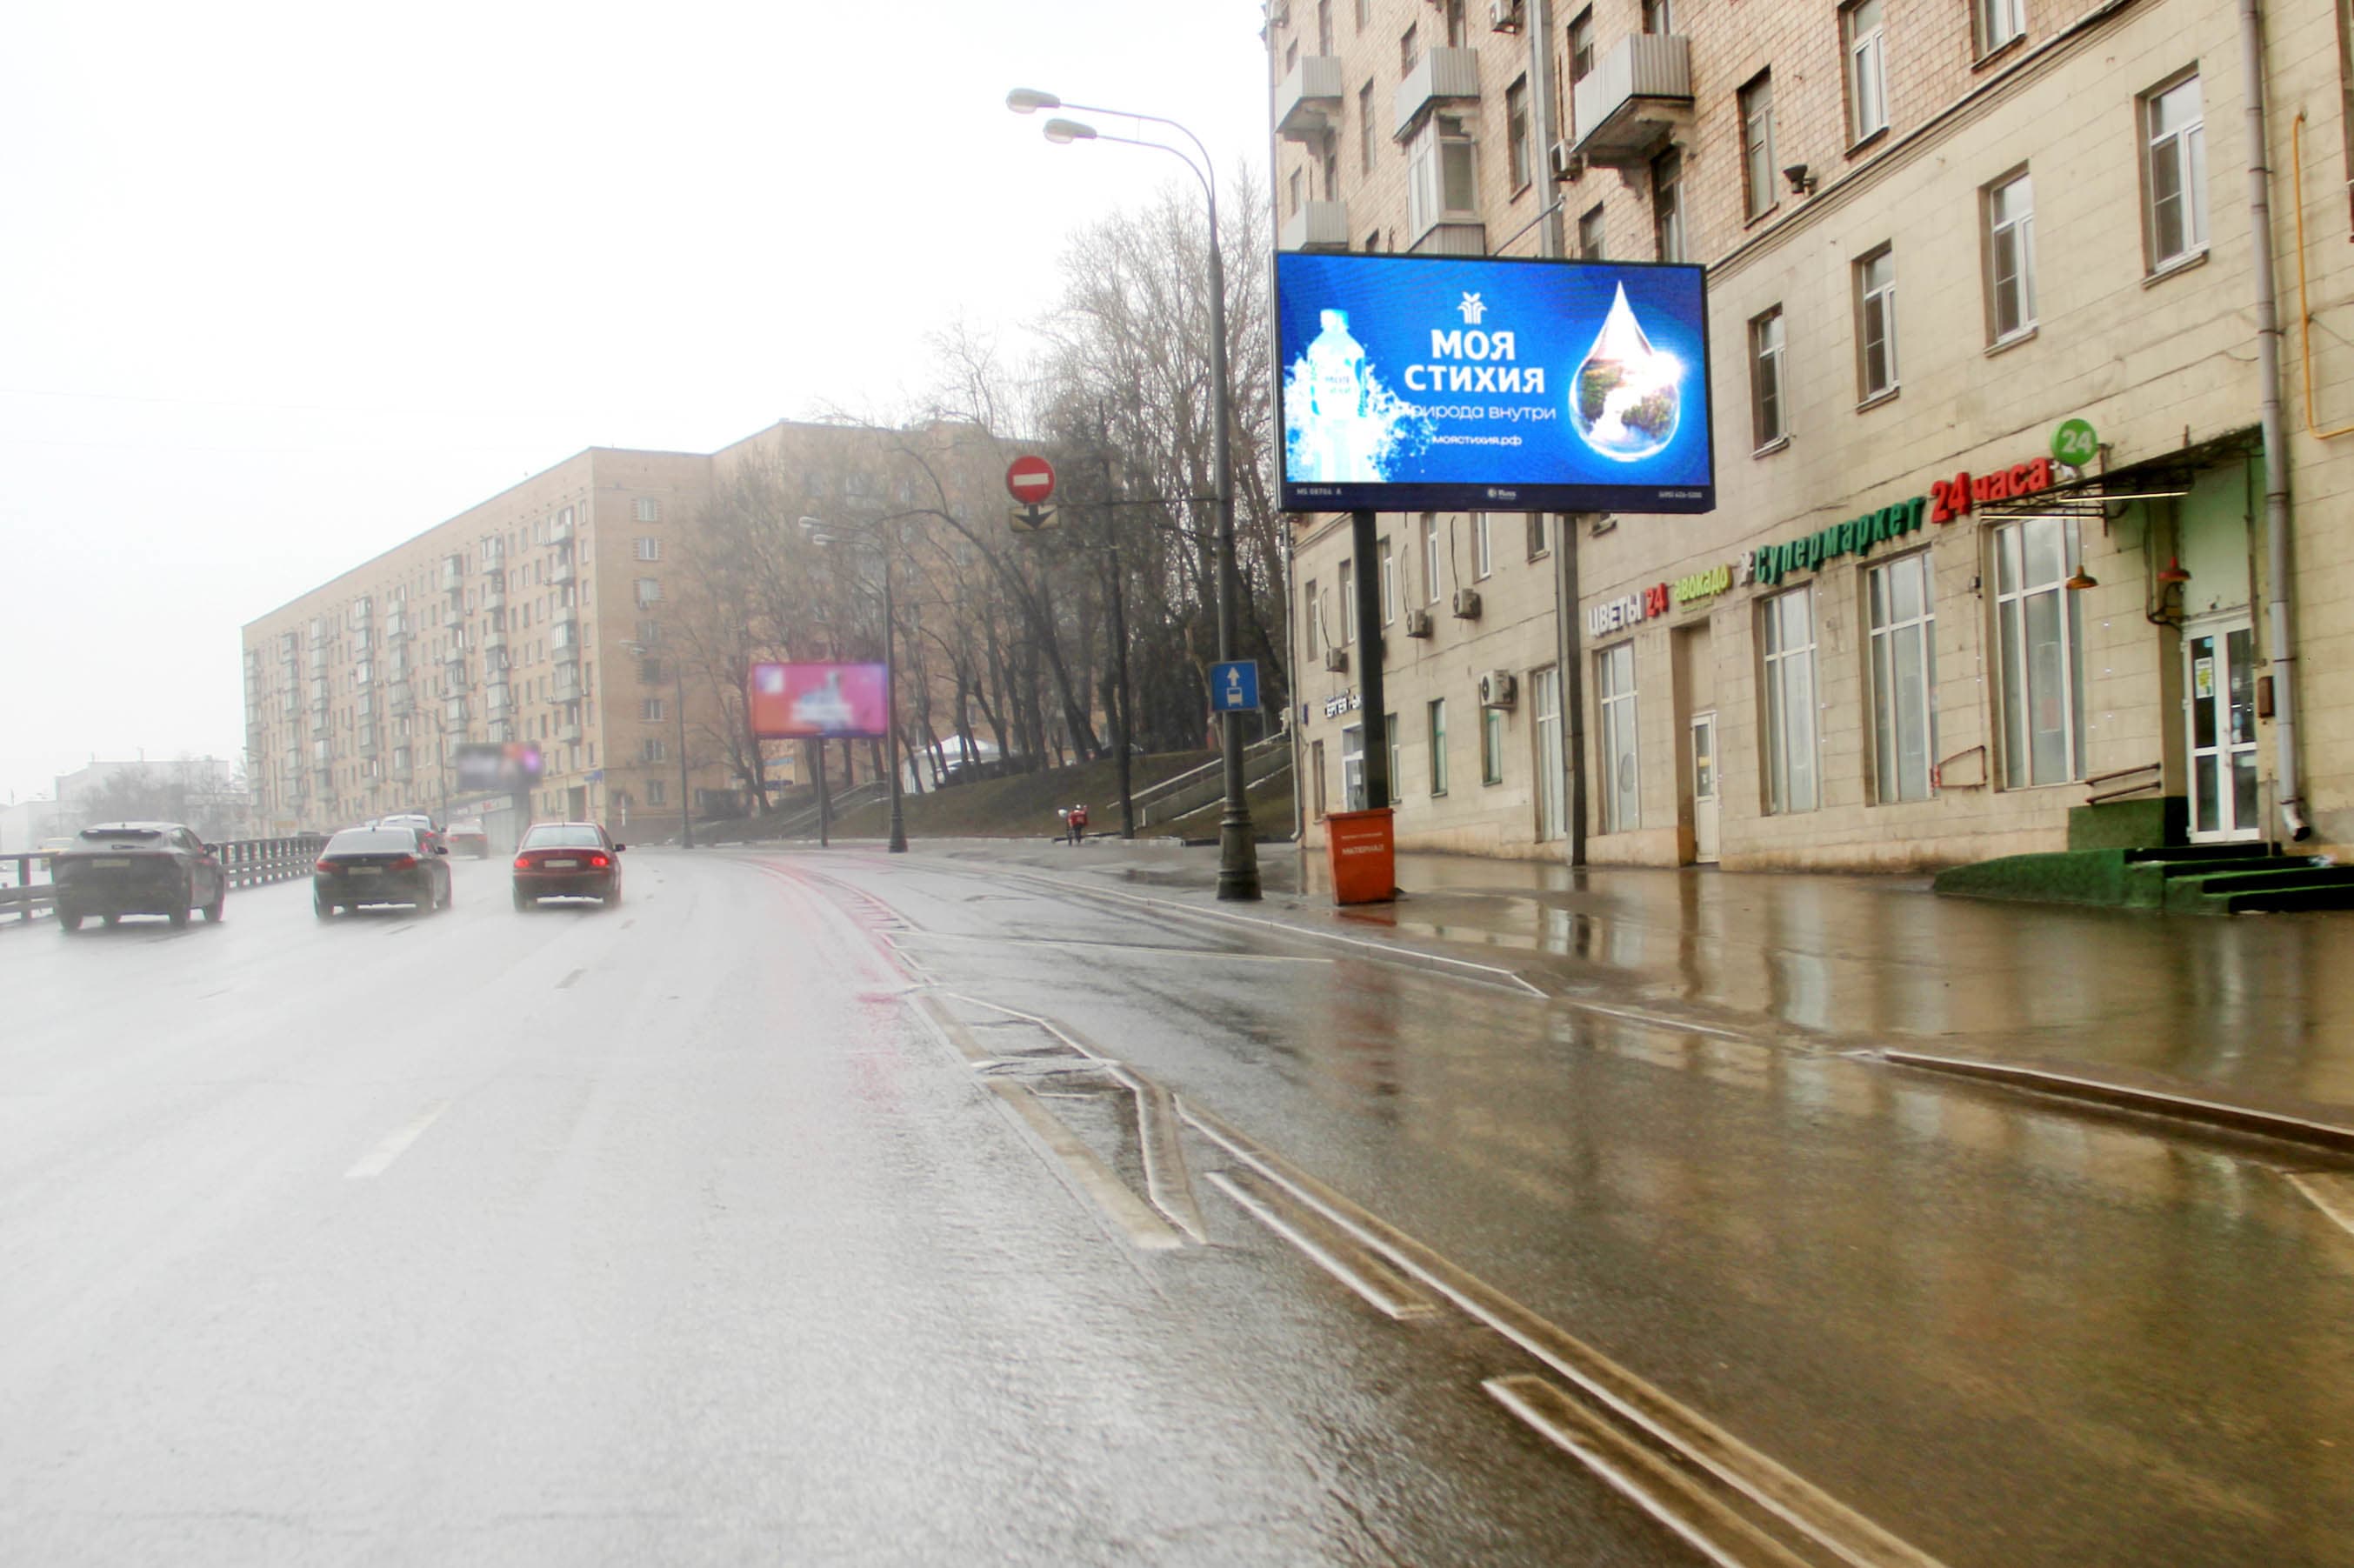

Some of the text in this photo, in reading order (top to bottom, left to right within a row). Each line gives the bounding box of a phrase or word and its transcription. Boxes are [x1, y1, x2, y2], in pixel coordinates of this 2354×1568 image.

[1430, 329, 1516, 361] МОЯ
[1404, 364, 1545, 394] СТИХИЯ
[1399, 404, 1557, 423] рирода внутри
[1432, 435, 1523, 448] моястихия.рф
[2061, 428, 2093, 455] 24
[1755, 457, 2053, 585] Супермаркет 24 часа
[1588, 564, 1733, 637] ЦВЕТЫ 24 авокадо
